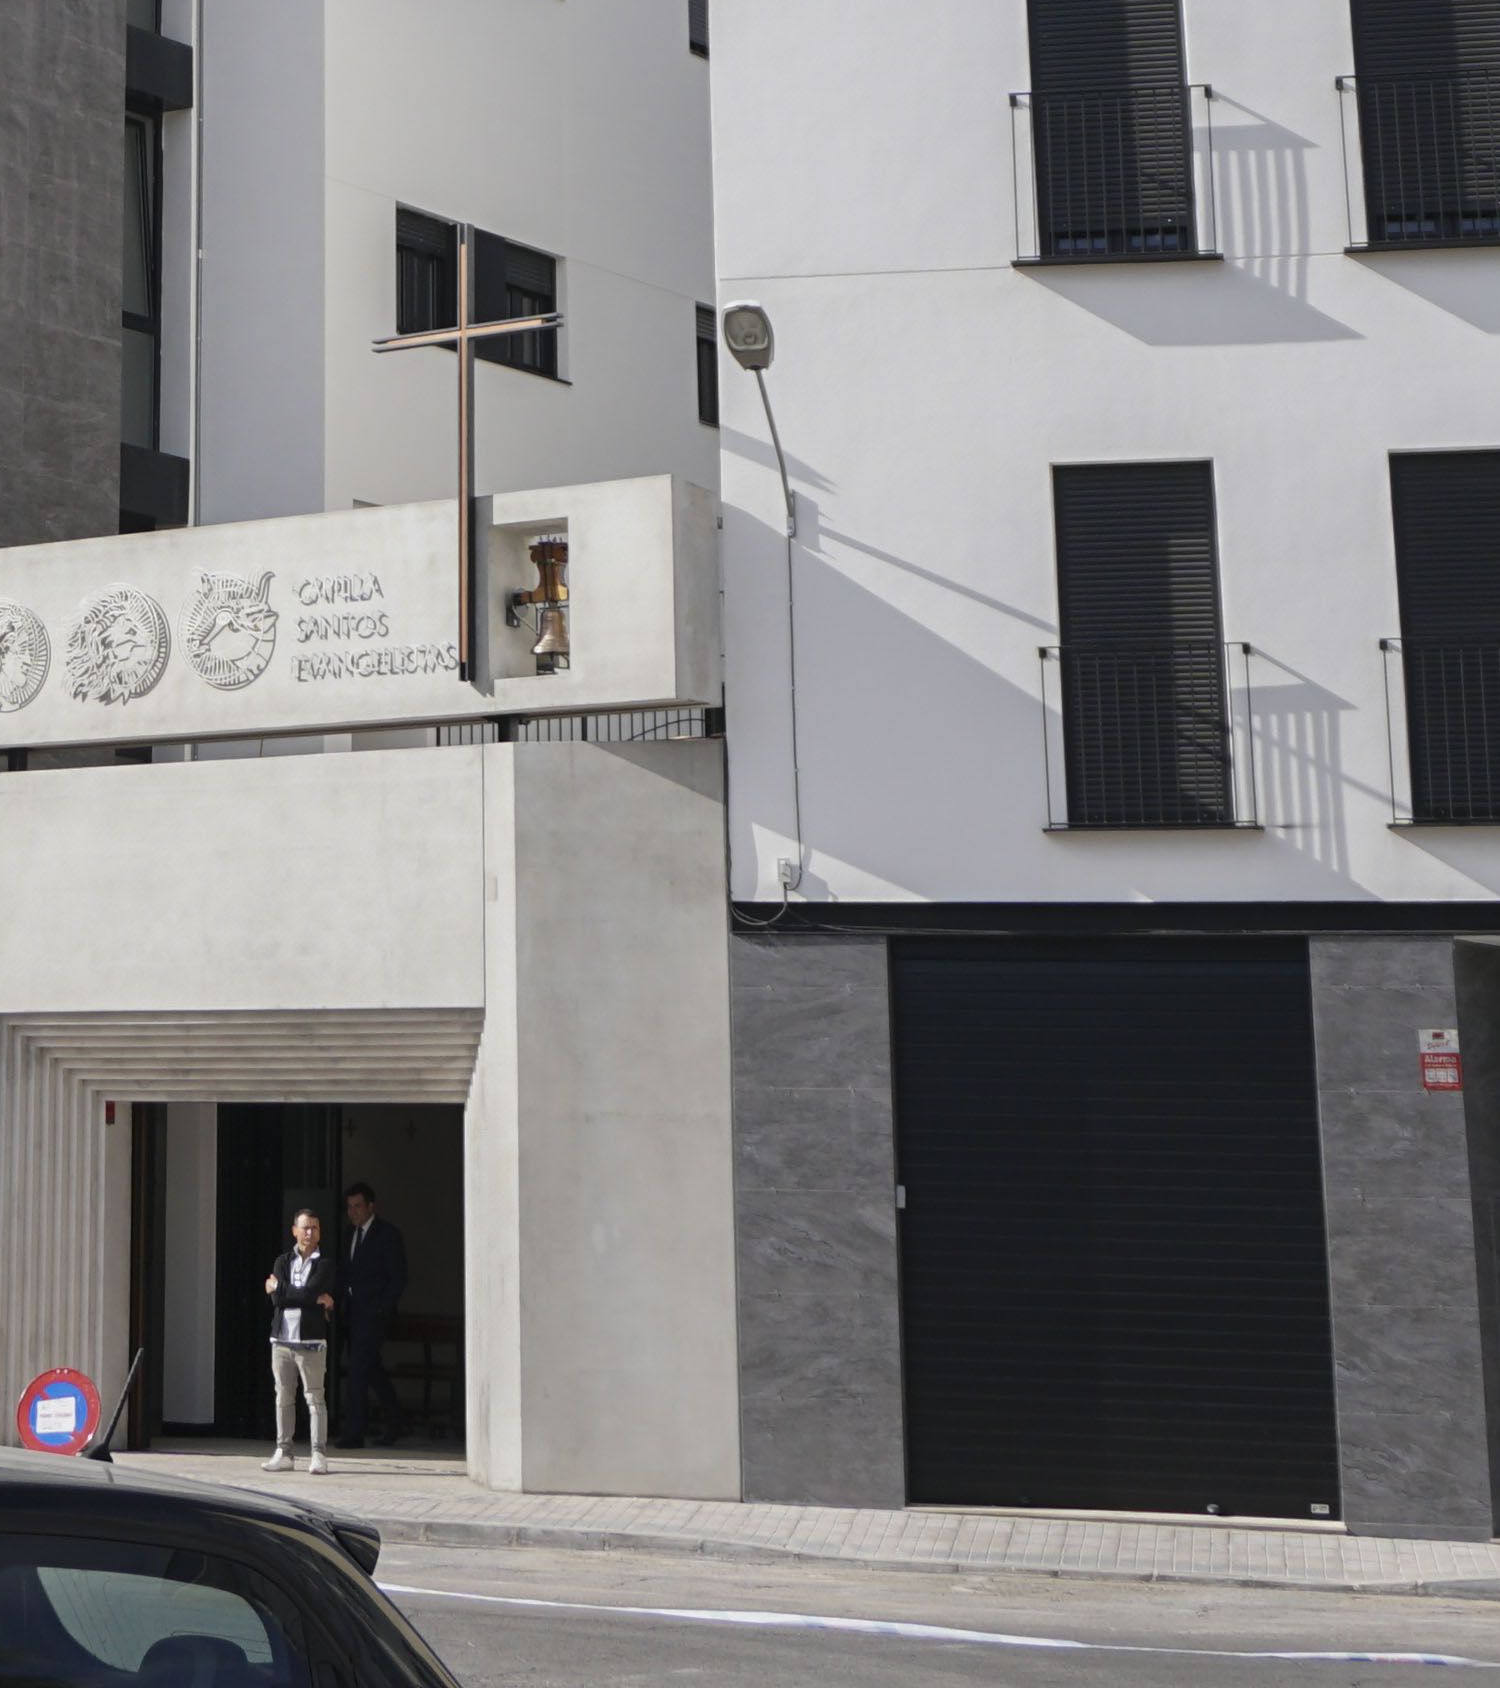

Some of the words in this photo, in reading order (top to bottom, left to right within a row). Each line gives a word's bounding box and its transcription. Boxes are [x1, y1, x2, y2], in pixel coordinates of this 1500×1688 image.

[293, 573, 384, 606] CAPILLA
[296, 610, 389, 643] SANTOS
[291, 642, 459, 682] EVANGELISTAS
